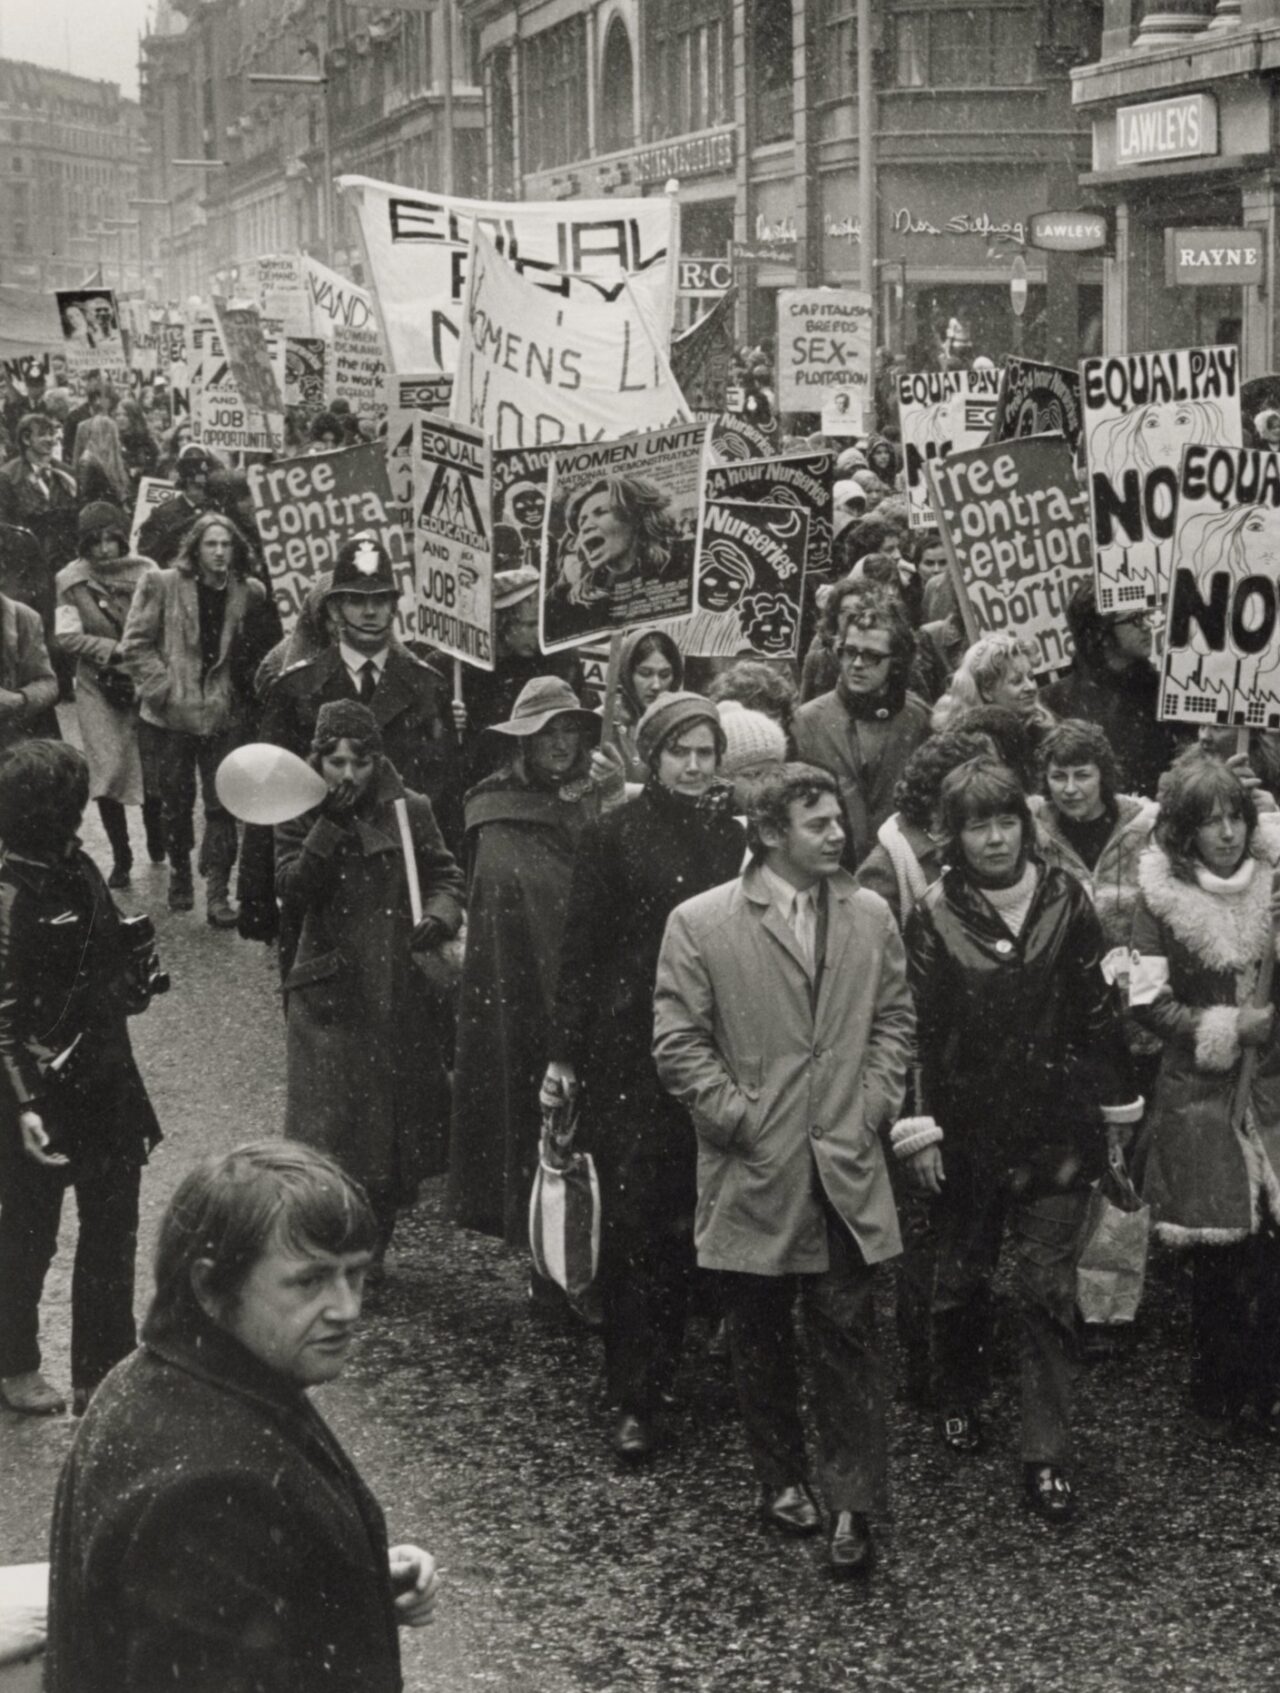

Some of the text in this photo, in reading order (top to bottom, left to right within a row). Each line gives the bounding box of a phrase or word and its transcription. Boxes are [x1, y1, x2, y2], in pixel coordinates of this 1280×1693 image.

[1120, 104, 1200, 155] LAWLEYS
[1179, 247, 1257, 267] RAYNE
[790, 303, 873, 317] CAPITALISM
[792, 337, 858, 365] SEX-
[351, 375, 385, 389] work
[1085, 353, 1189, 412] EQUAL
[1191, 348, 1237, 400] PAY
[208, 410, 244, 429] JOB
[421, 431, 485, 470] EQUAL
[496, 455, 525, 484] 24
[555, 442, 638, 476] WOMEN
[645, 428, 706, 455] UNITE
[558, 468, 608, 487] NATIONAL
[612, 447, 700, 474] DEMONSTRATION
[247, 460, 336, 509] free
[705, 472, 727, 500] 24
[726, 465, 766, 486] hour
[764, 463, 831, 507] Nurseries
[930, 454, 1020, 508] free
[1093, 467, 1178, 546] NO
[420, 515, 491, 552] EDUCATION
[422, 541, 450, 561] AND
[703, 505, 798, 581] Nurseries
[423, 567, 456, 608] JOB
[418, 603, 491, 661] OPPORTUNITIES
